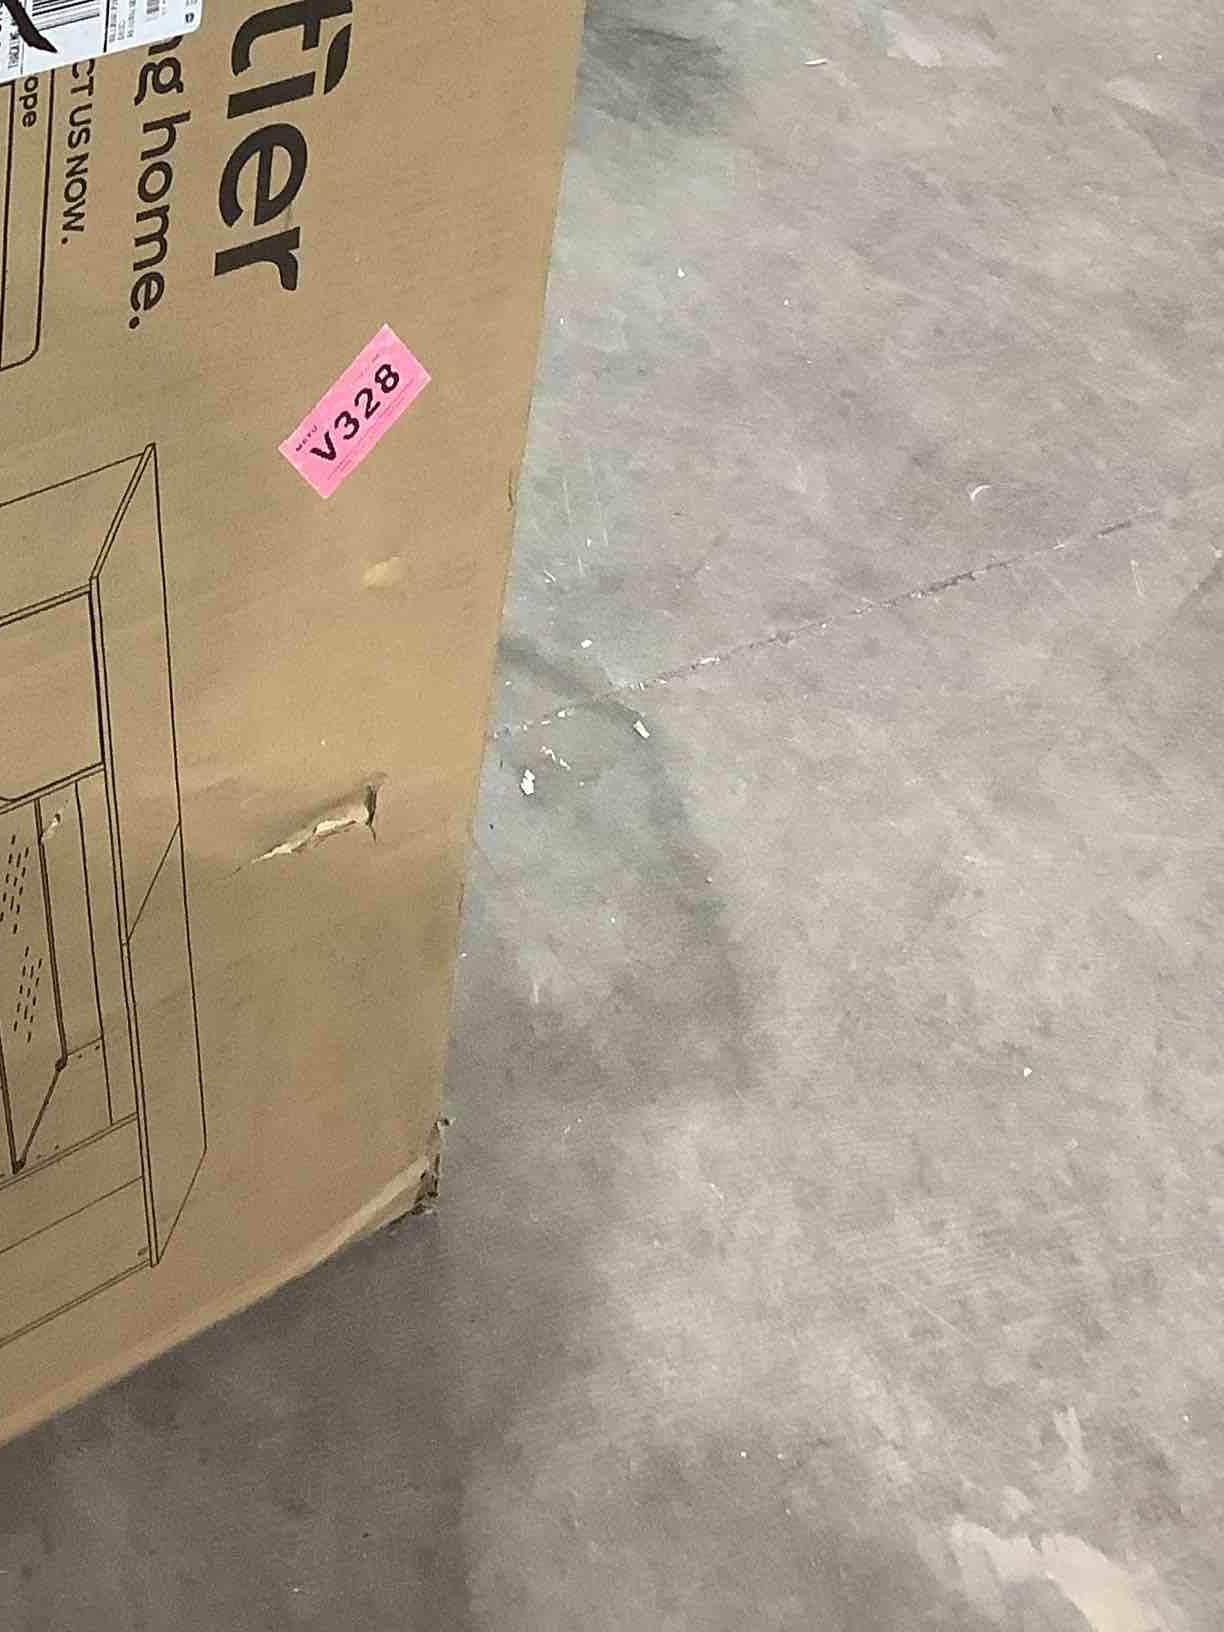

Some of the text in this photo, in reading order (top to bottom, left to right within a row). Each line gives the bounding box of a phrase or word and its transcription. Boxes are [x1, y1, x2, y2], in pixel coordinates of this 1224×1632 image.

[67, 102, 93, 145] US
[60, 148, 92, 246] NOW.
[128, 111, 192, 331] home.
[310, 363, 400, 461] V328
